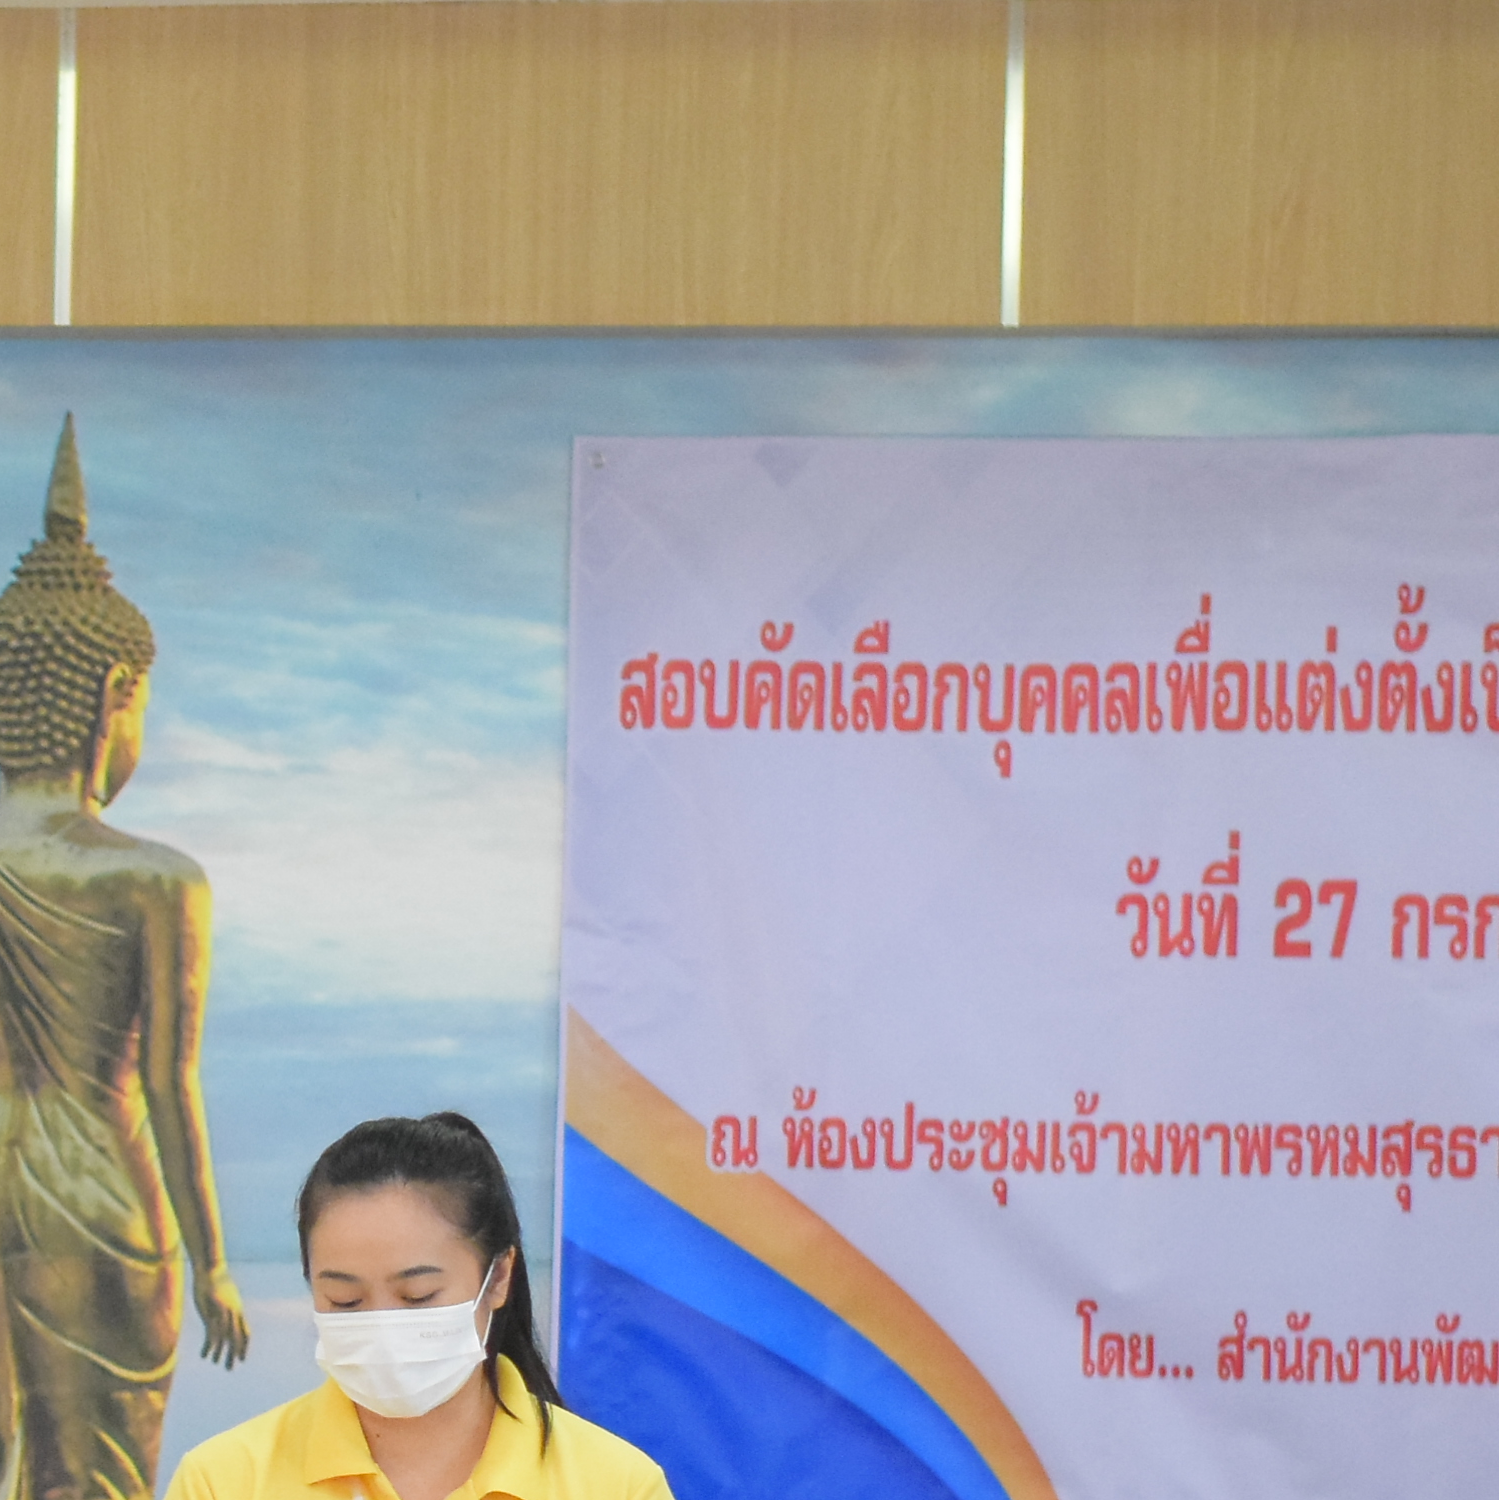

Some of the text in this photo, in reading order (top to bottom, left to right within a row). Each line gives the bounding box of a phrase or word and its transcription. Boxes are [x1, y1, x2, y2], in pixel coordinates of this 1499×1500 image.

[1115, 830, 1241, 959] วันที่
[1272, 878, 1358, 959] 27
[710, 1114, 759, 1170] ณ
[1076, 1299, 1195, 1381] โดย...
